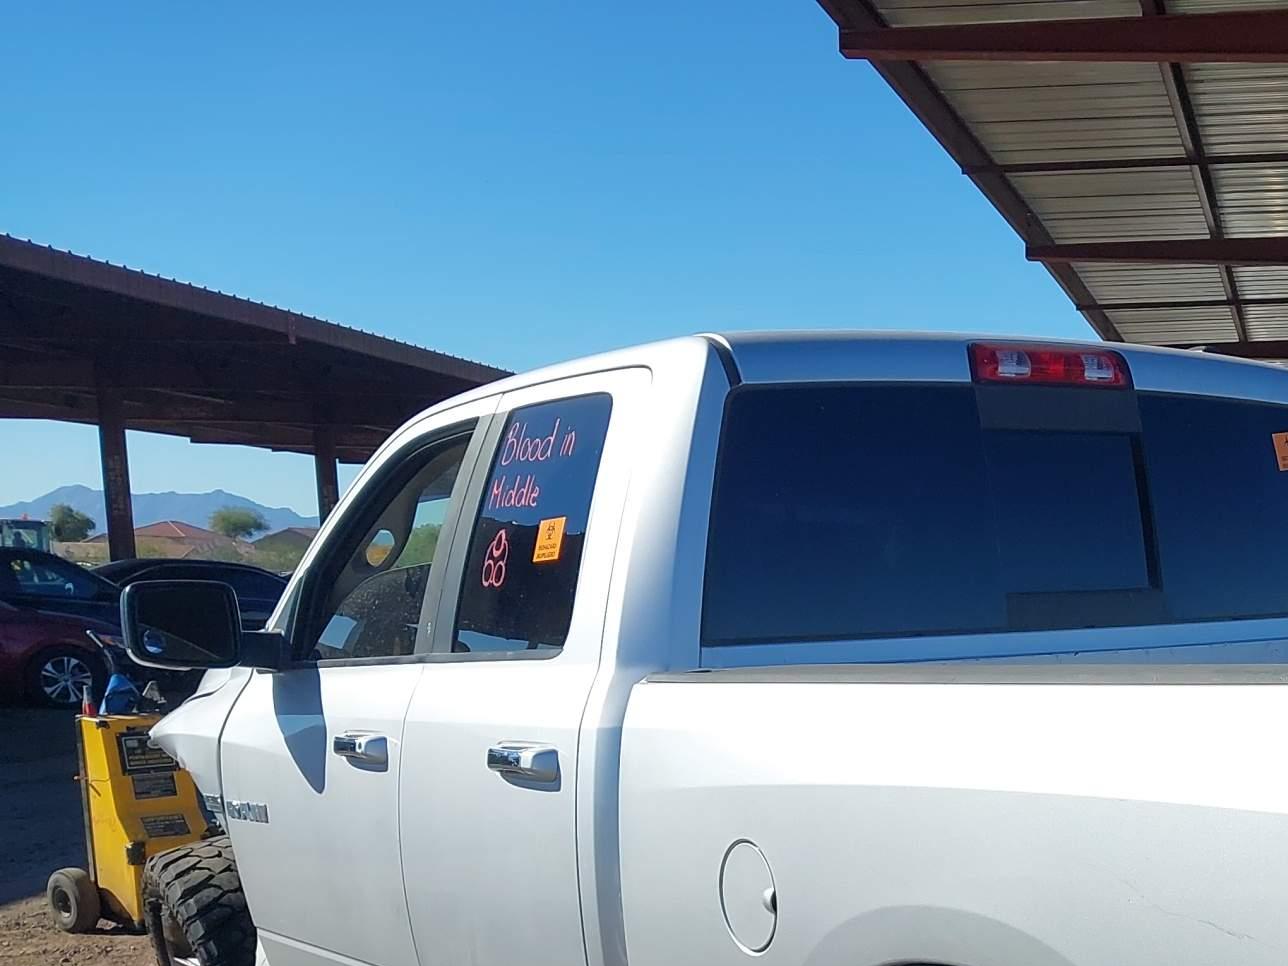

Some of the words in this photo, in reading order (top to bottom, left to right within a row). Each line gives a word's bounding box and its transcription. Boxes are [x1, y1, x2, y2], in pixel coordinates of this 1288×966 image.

[501, 418, 561, 466] Blood
[560, 425, 576, 457] in
[488, 475, 540, 510] Middle
